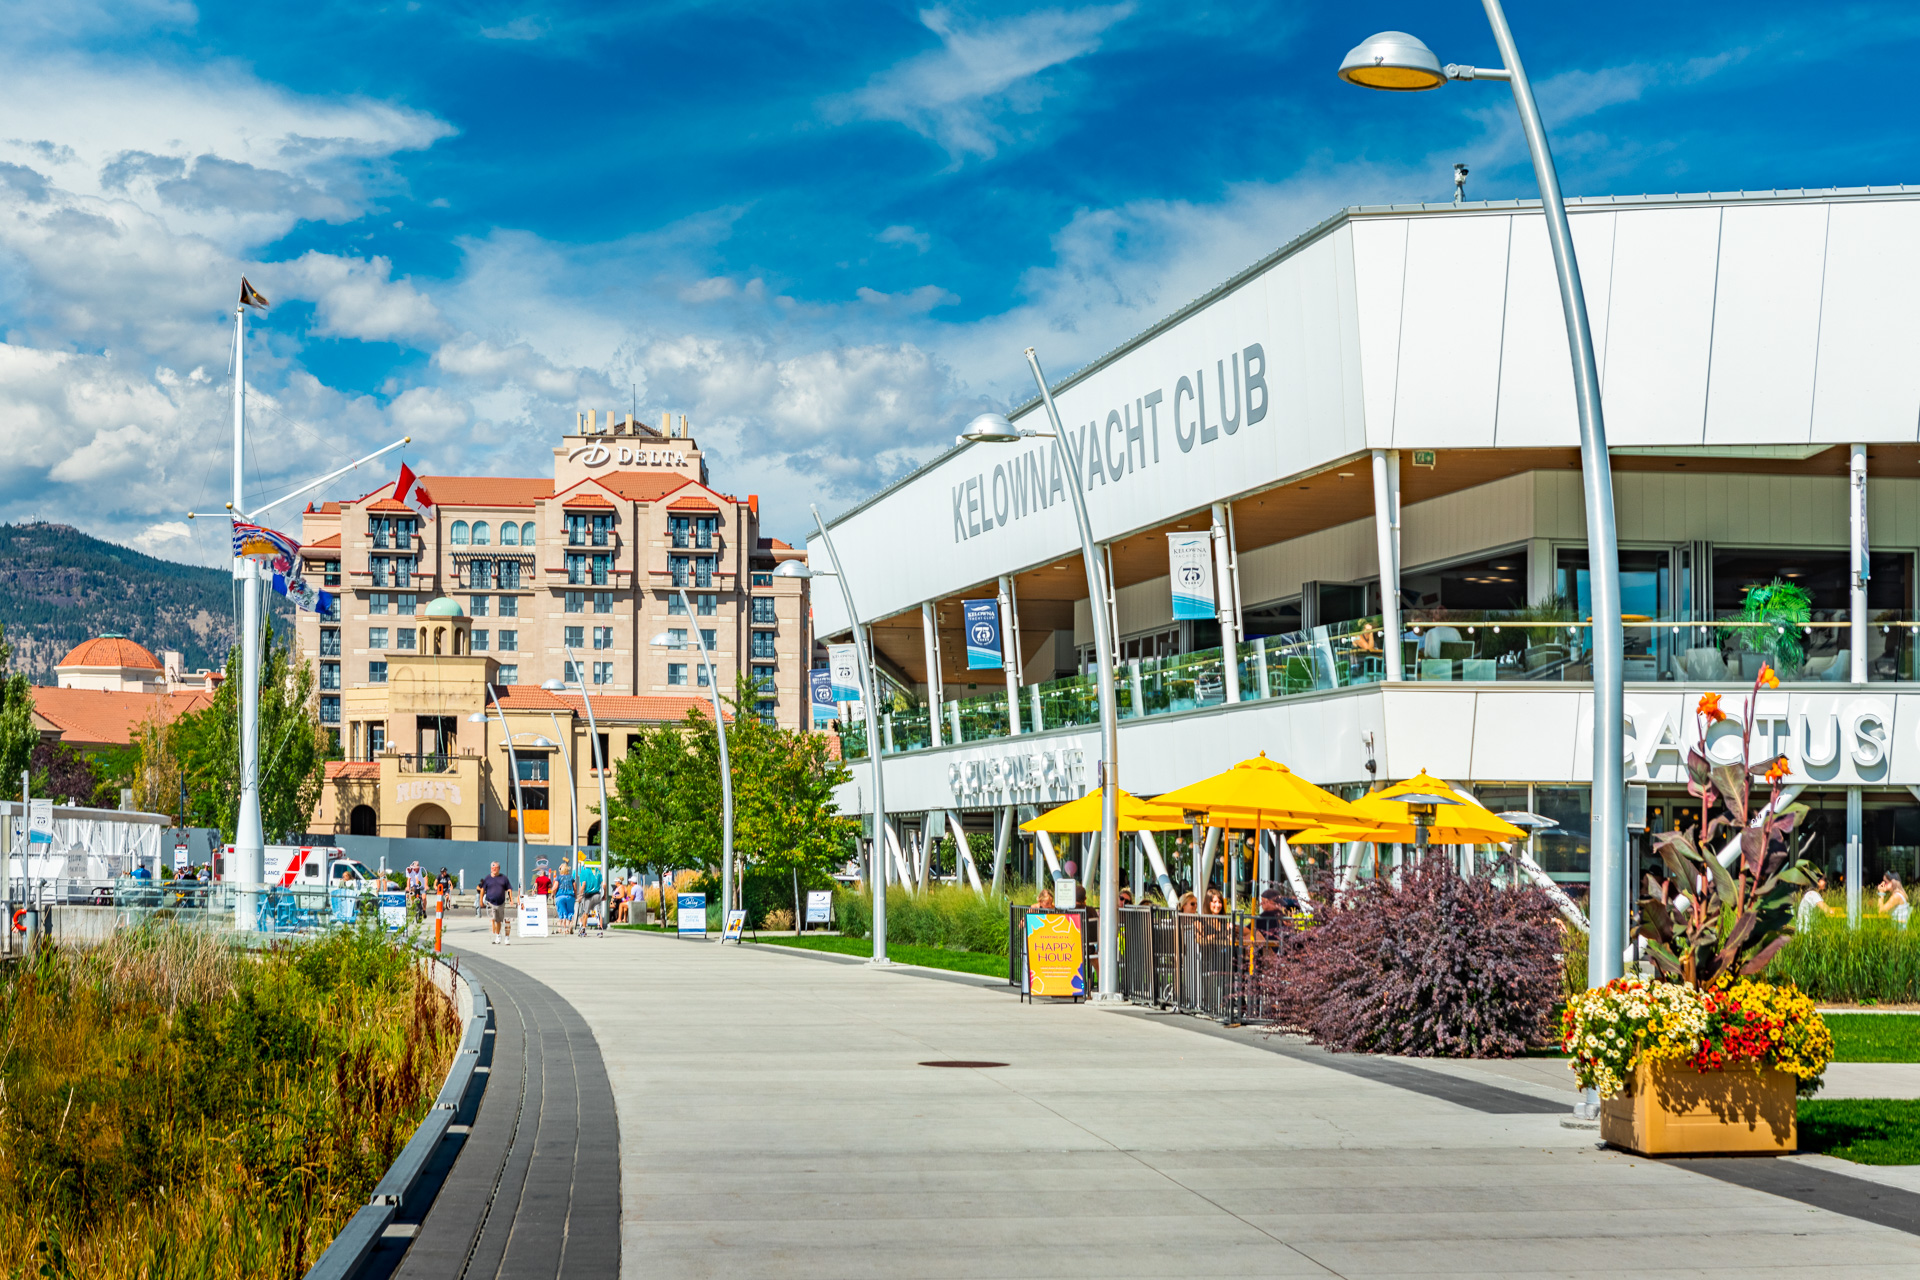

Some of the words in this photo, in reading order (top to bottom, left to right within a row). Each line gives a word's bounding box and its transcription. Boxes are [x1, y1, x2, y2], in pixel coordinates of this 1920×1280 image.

[952, 440, 1066, 544] KELOWNA
[1069, 388, 1163, 494] YACHT
[1174, 342, 1269, 454] CLUB
[617, 445, 688, 467] DELTA
[1173, 547, 1207, 555] KELOWNA
[1182, 567, 1201, 581] 75
[975, 626, 991, 639] 75
[838, 667, 851, 677] 75
[817, 688, 830, 698] 75
[1622, 712, 1886, 767] ACTUS
[36, 816, 46, 824] 75
[1034, 942, 1076, 952] HAPPY
[1037, 952, 1073, 963] HOUR
